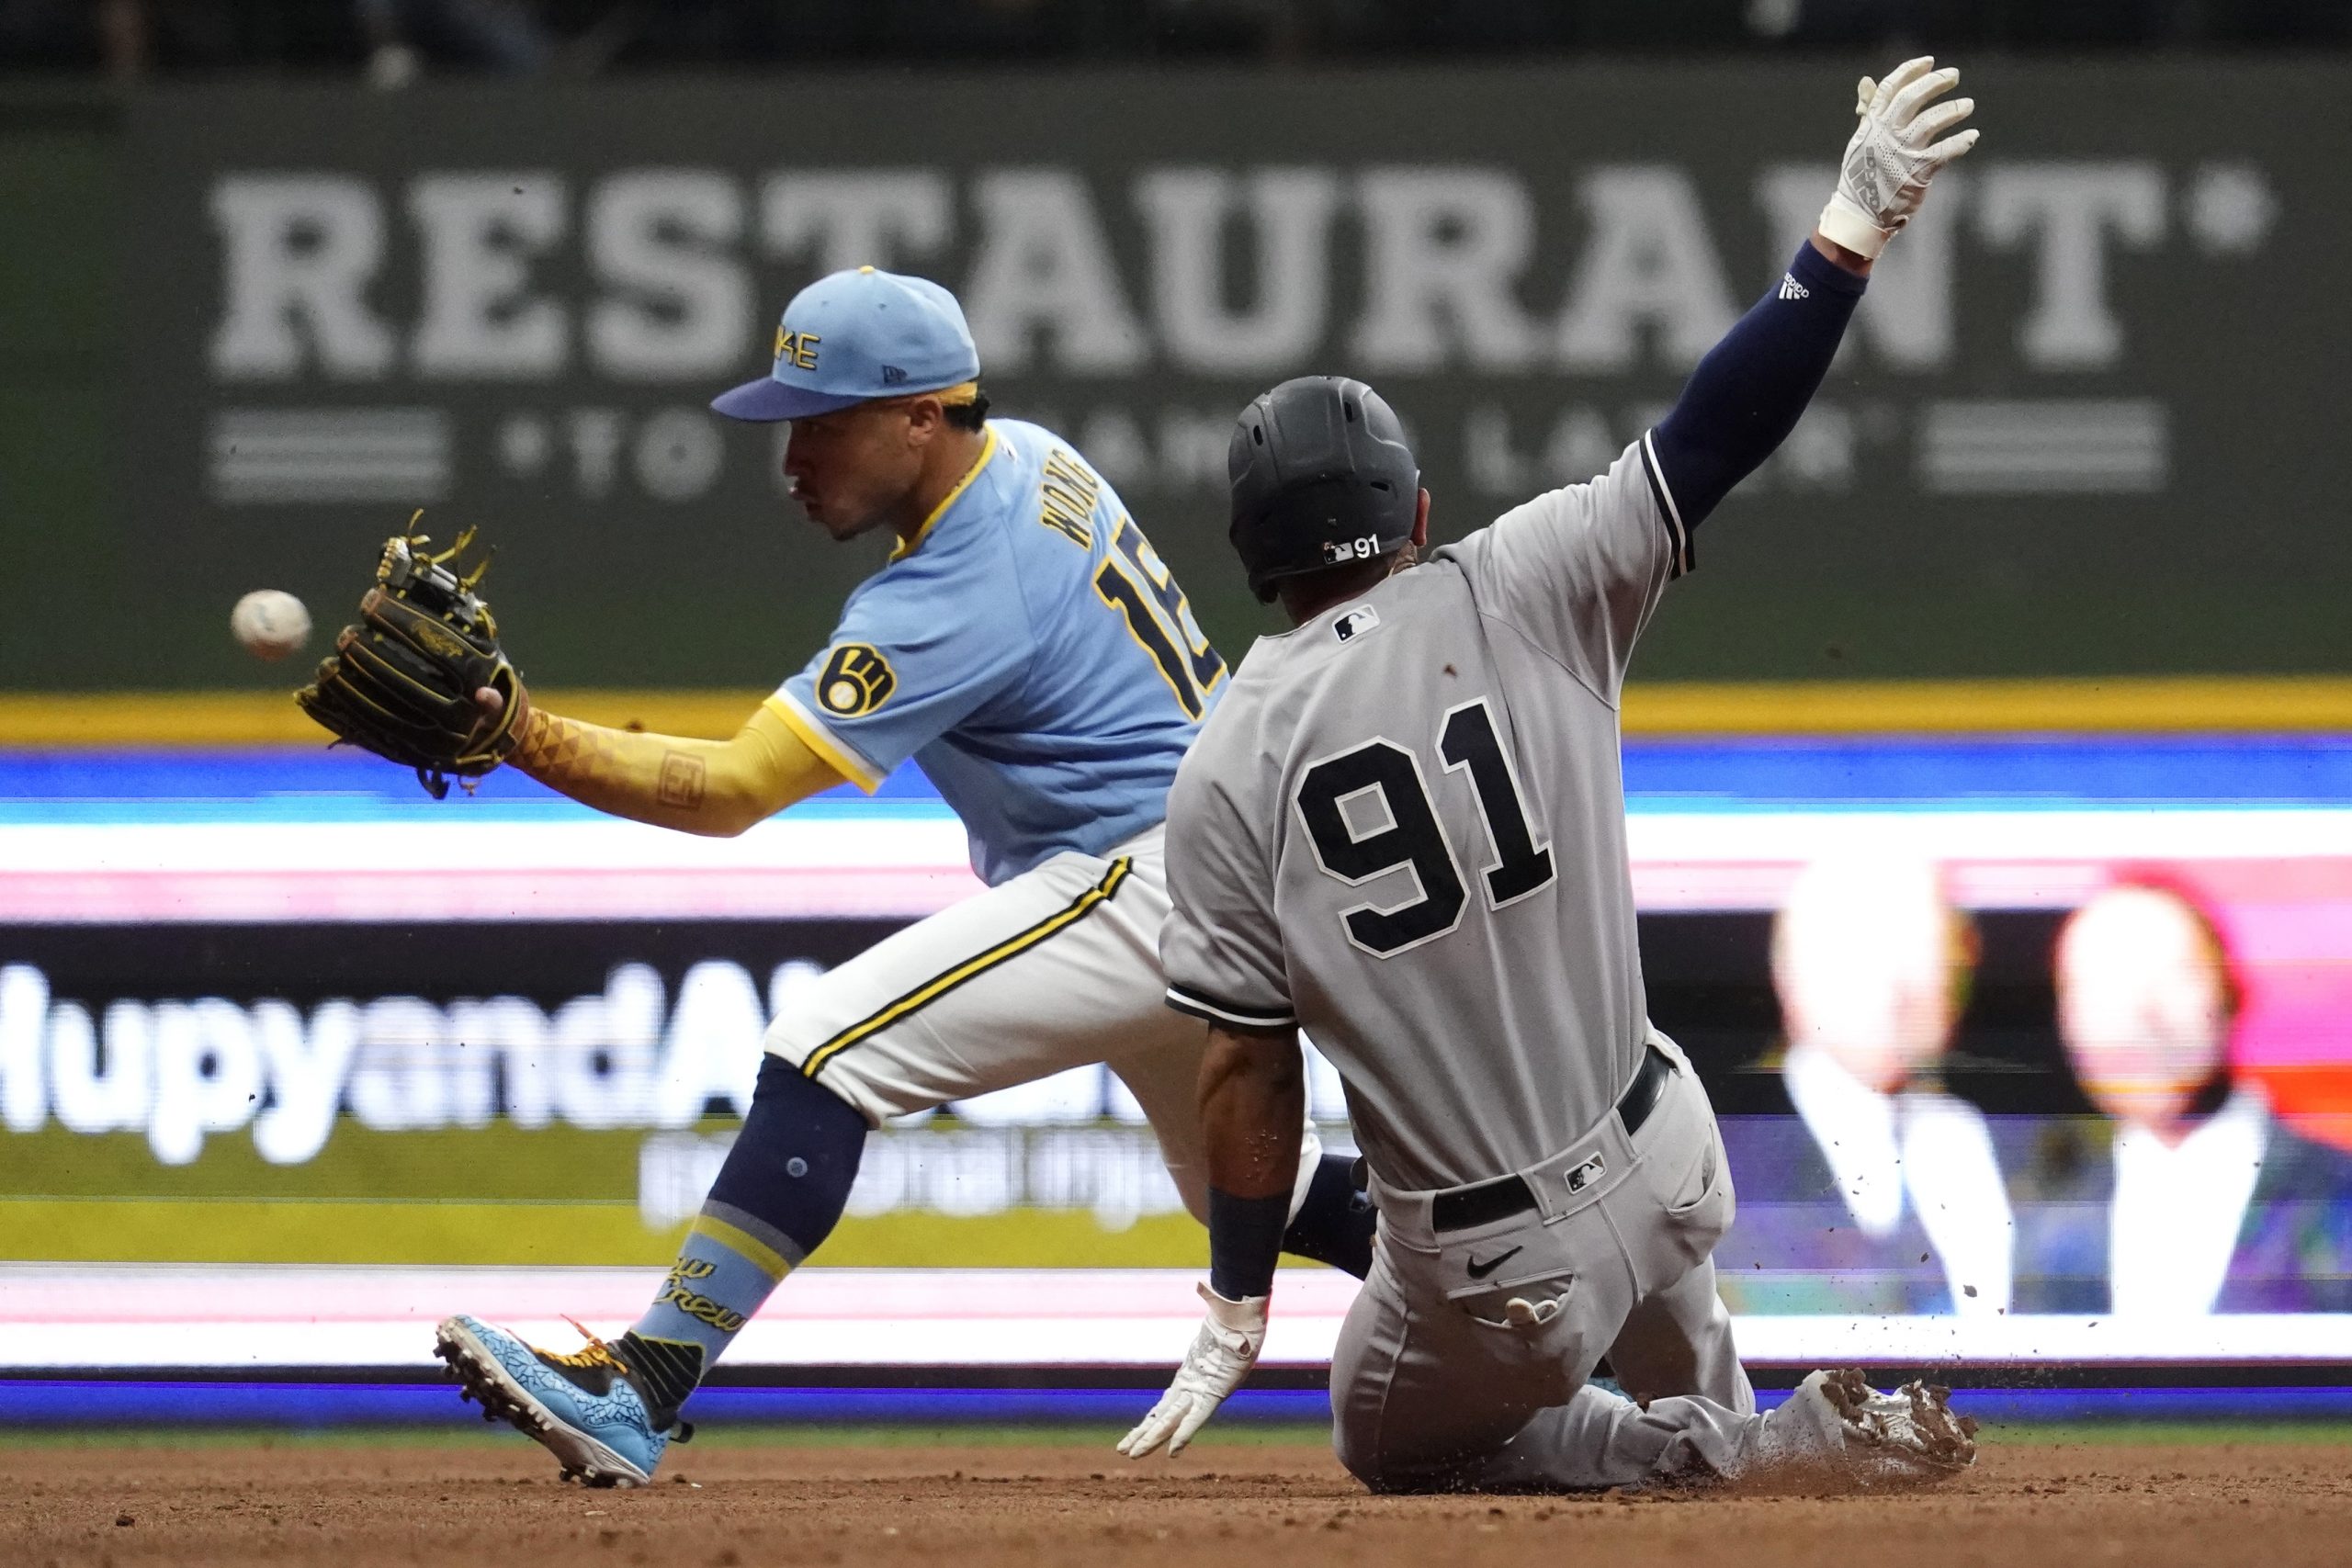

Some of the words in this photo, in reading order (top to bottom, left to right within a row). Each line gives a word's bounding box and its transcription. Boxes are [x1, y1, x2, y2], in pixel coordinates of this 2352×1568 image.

[1784, 271, 1810, 299] adidas
[1040, 447, 1099, 551] WONG
[1354, 533, 1381, 558] 91
[1290, 694, 1559, 961] 91
